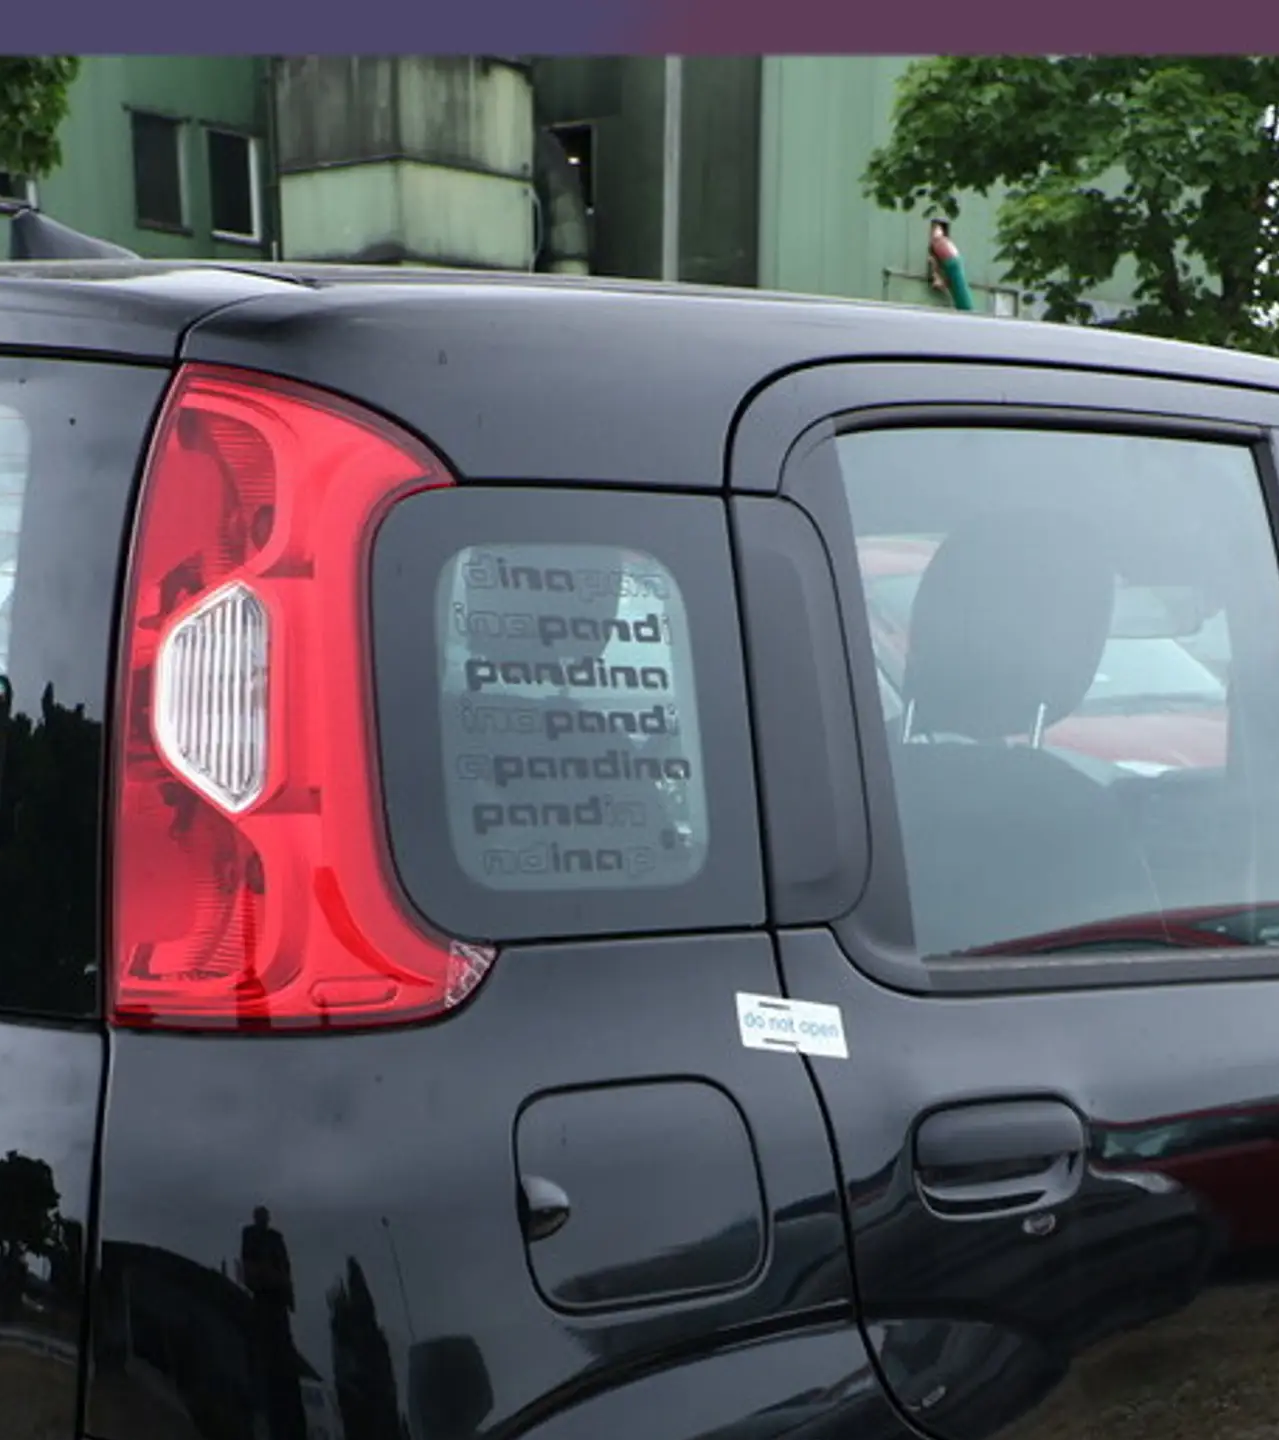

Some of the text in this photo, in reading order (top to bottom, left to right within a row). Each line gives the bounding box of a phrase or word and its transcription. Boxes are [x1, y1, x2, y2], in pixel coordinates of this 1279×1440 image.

[465, 656, 668, 691] pandina
[743, 1012, 839, 1038] do not open
